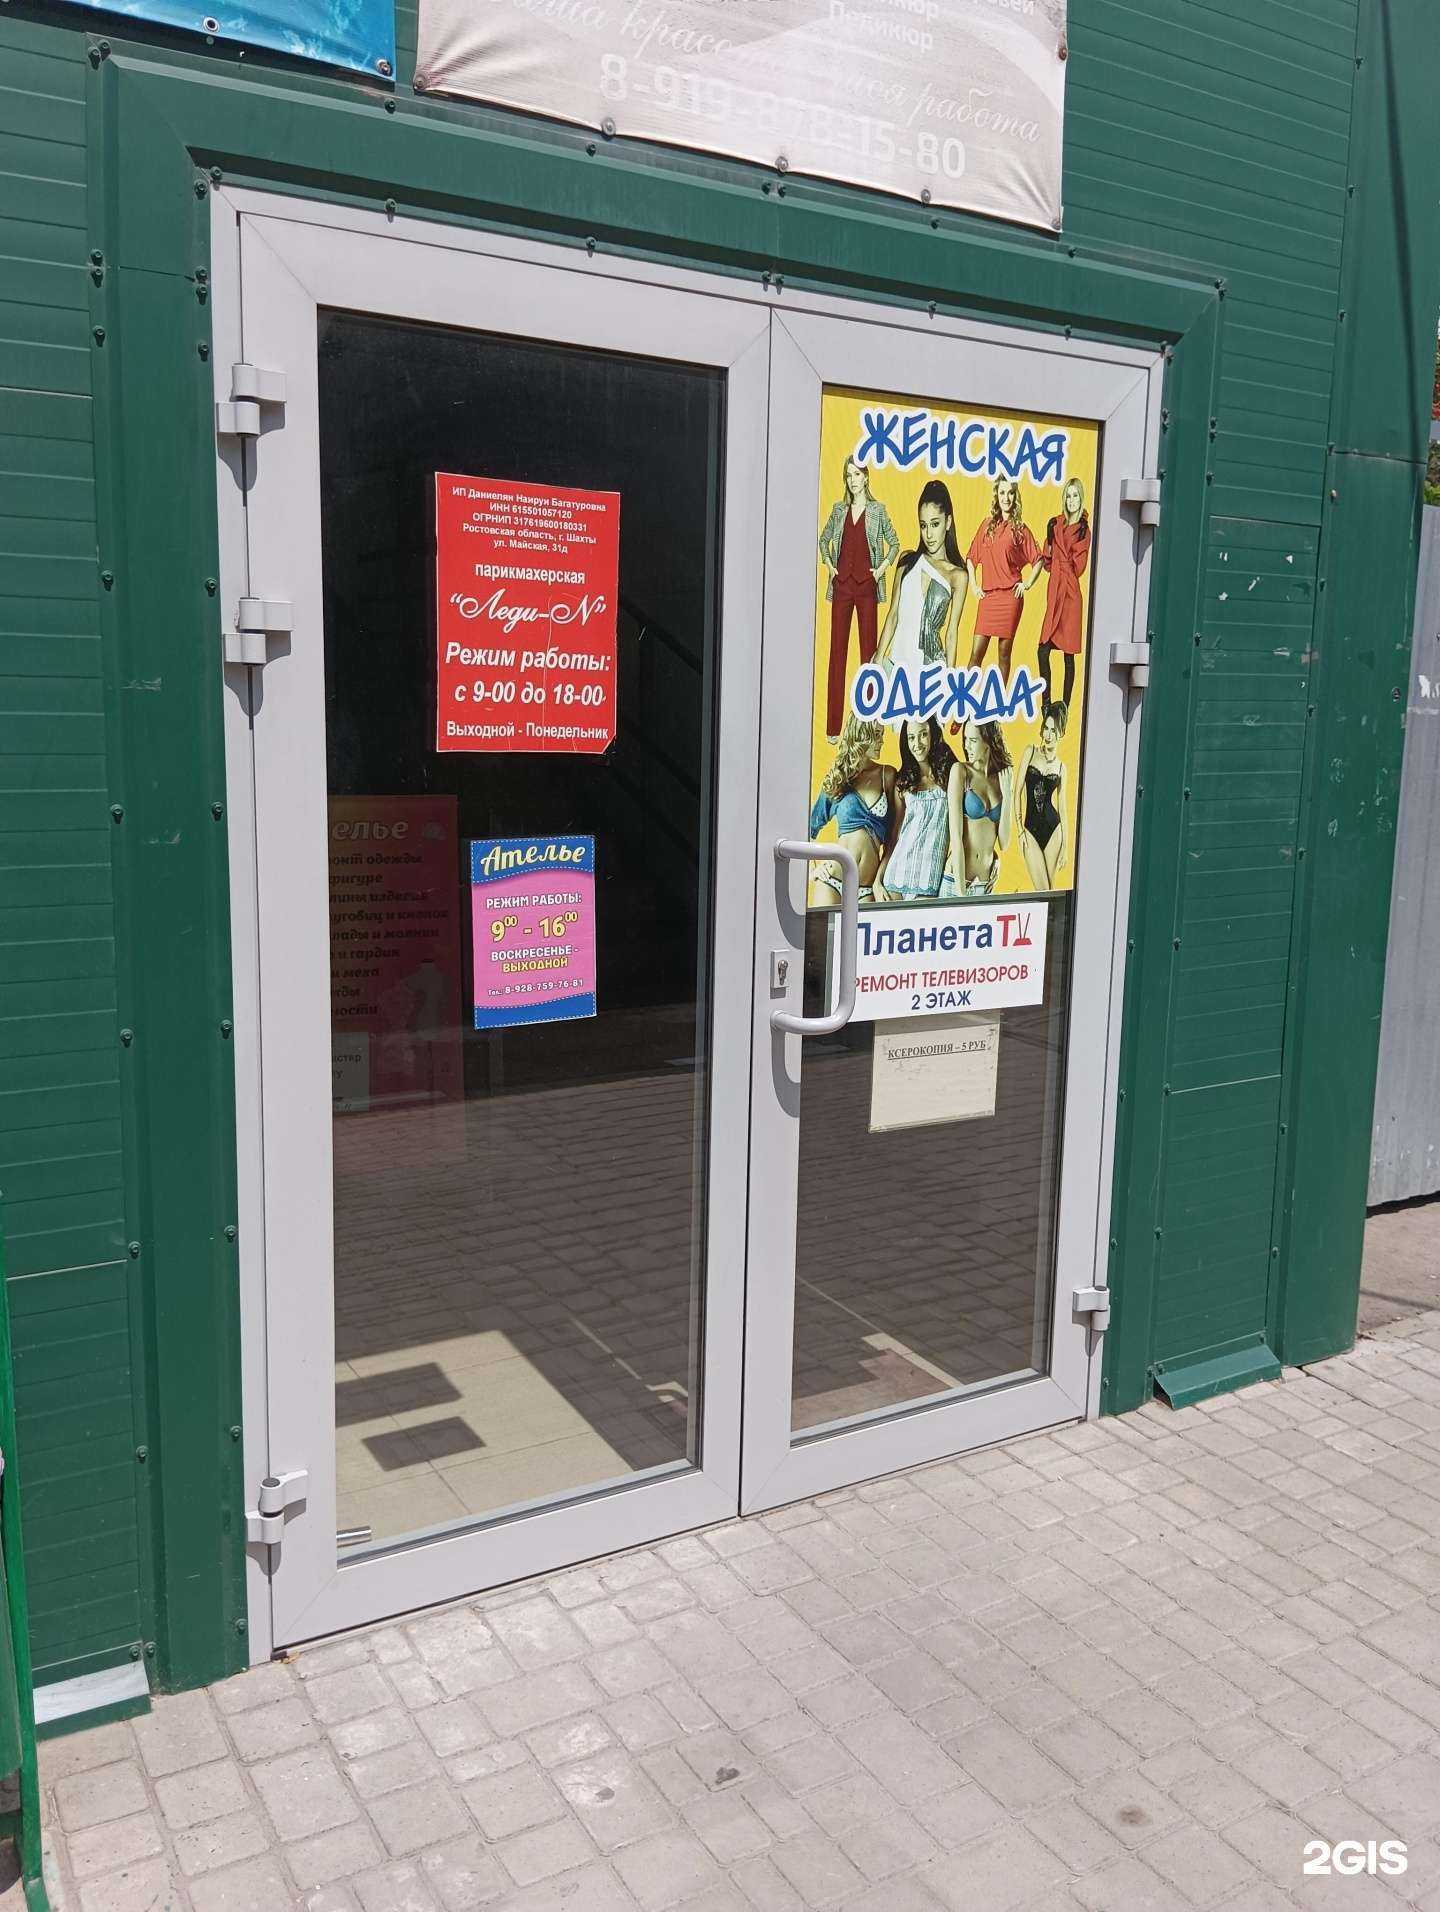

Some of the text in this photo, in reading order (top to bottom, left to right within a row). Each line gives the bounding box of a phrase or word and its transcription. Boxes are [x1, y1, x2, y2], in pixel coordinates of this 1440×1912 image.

[907, 82, 1041, 143] работа
[857, 411, 1067, 482] ЖЕНСКАЯ
[452, 486, 466, 496] ИП
[468, 488, 514, 502] Даниелян
[551, 498, 607, 512] Багатуровна
[472, 513, 512, 525] ОГРНИП
[490, 502, 572, 519] ИНН 615501057120
[463, 523, 515, 537] Ростовская
[518, 528, 557, 542] область,
[567, 534, 597, 544] Шахты
[493, 538, 568, 554] ул. Майская, 31д
[475, 563, 586, 585] парикмахерская
[445, 642, 612, 673] Режим работы:
[454, 681, 604, 706] с 9-00 до 18-00
[854, 665, 1043, 720] ОДЕЖДА
[447, 721, 515, 739] Выходной
[526, 722, 609, 740] Понедельник
[332, 819, 409, 841] елье
[331, 853, 364, 865] онт
[480, 844, 586, 876] Ателье
[486, 893, 582, 909] РЕЖИМ РАБОТЫ:
[332, 910, 384, 925] уговиц
[491, 944, 572, 962] ВОСКРЕСЕНЬЕ
[502, 956, 569, 973] ВЫХОДНОЙ
[922, 964, 1029, 988] ТЕЛЕВИЗОРОВ
[505, 979, 583, 995] 8-928-759-76-81
[911, 990, 972, 1010] 2 ЭТАЖ
[888, 1043, 953, 1059] КСЕРОКОПИЯ
[961, 1042, 967, 1051] 5
